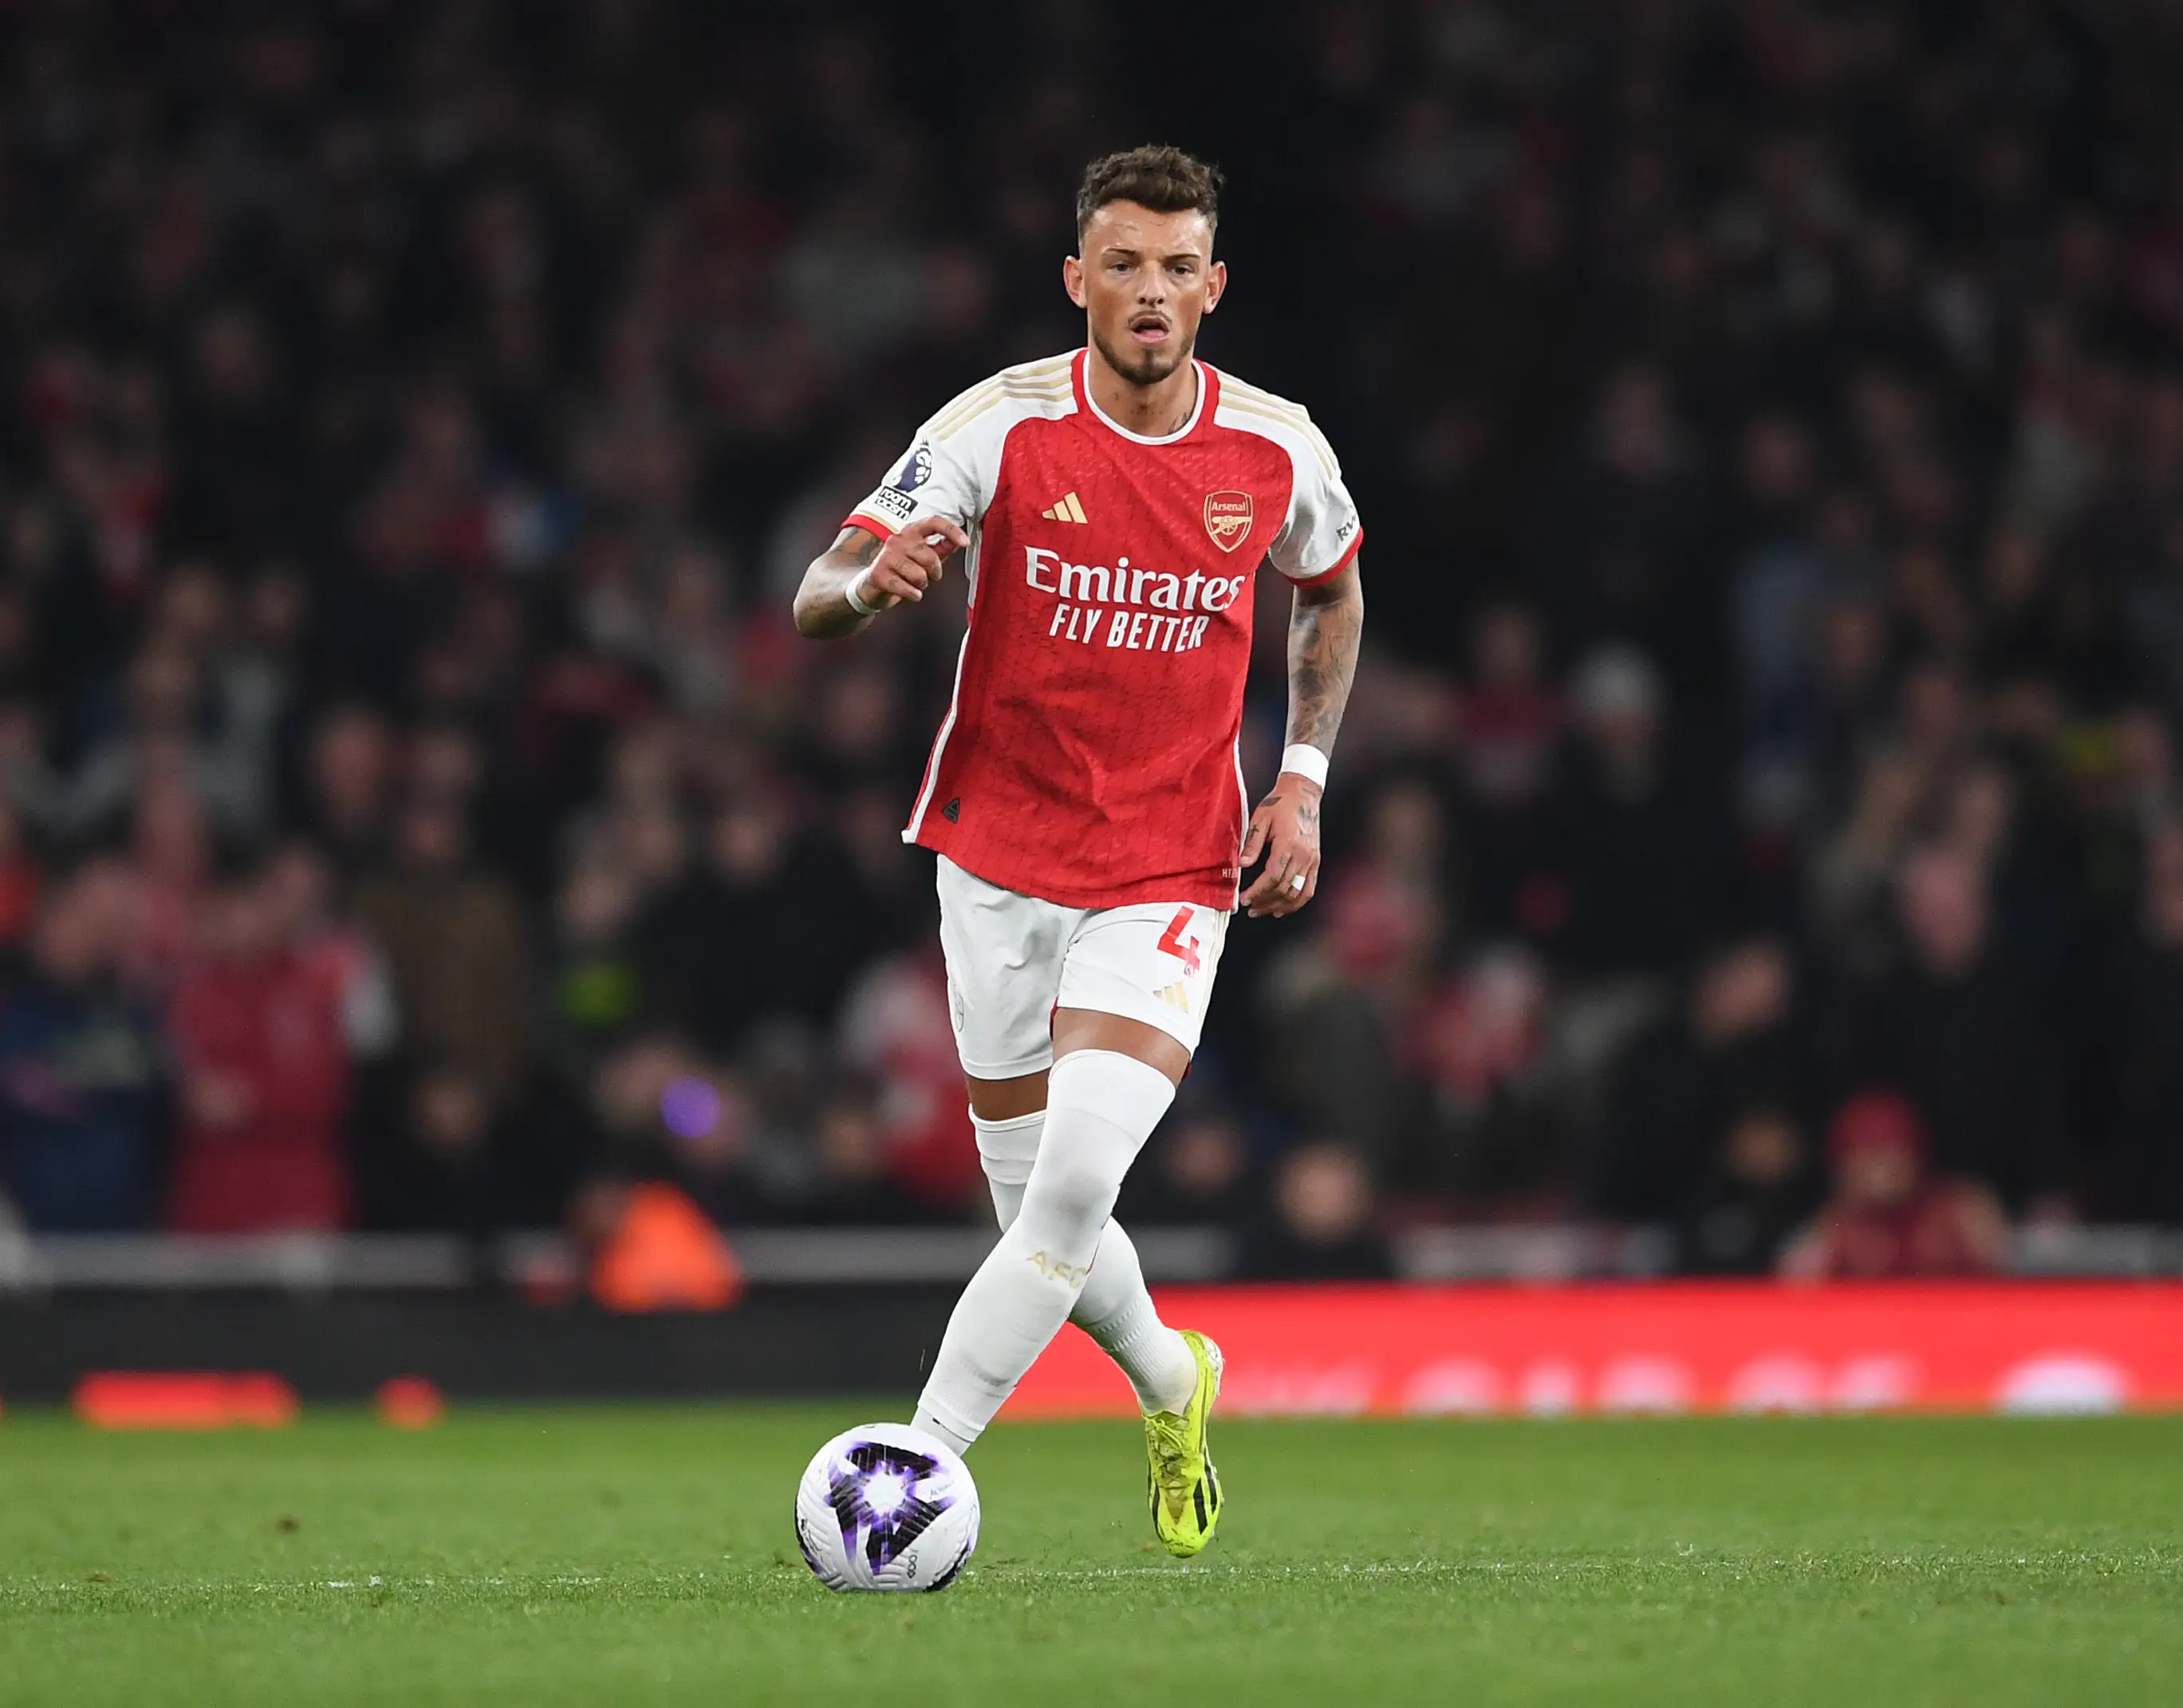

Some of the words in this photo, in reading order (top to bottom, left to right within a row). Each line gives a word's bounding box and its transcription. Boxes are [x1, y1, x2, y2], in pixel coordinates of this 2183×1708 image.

[880, 488, 912, 510] room
[1212, 501, 1247, 511] Arsenal
[1024, 545, 1246, 612] Emirates
[1048, 603, 1103, 645] FLY
[1105, 610, 1211, 653] BETTER
[1157, 905, 1200, 970] 4
